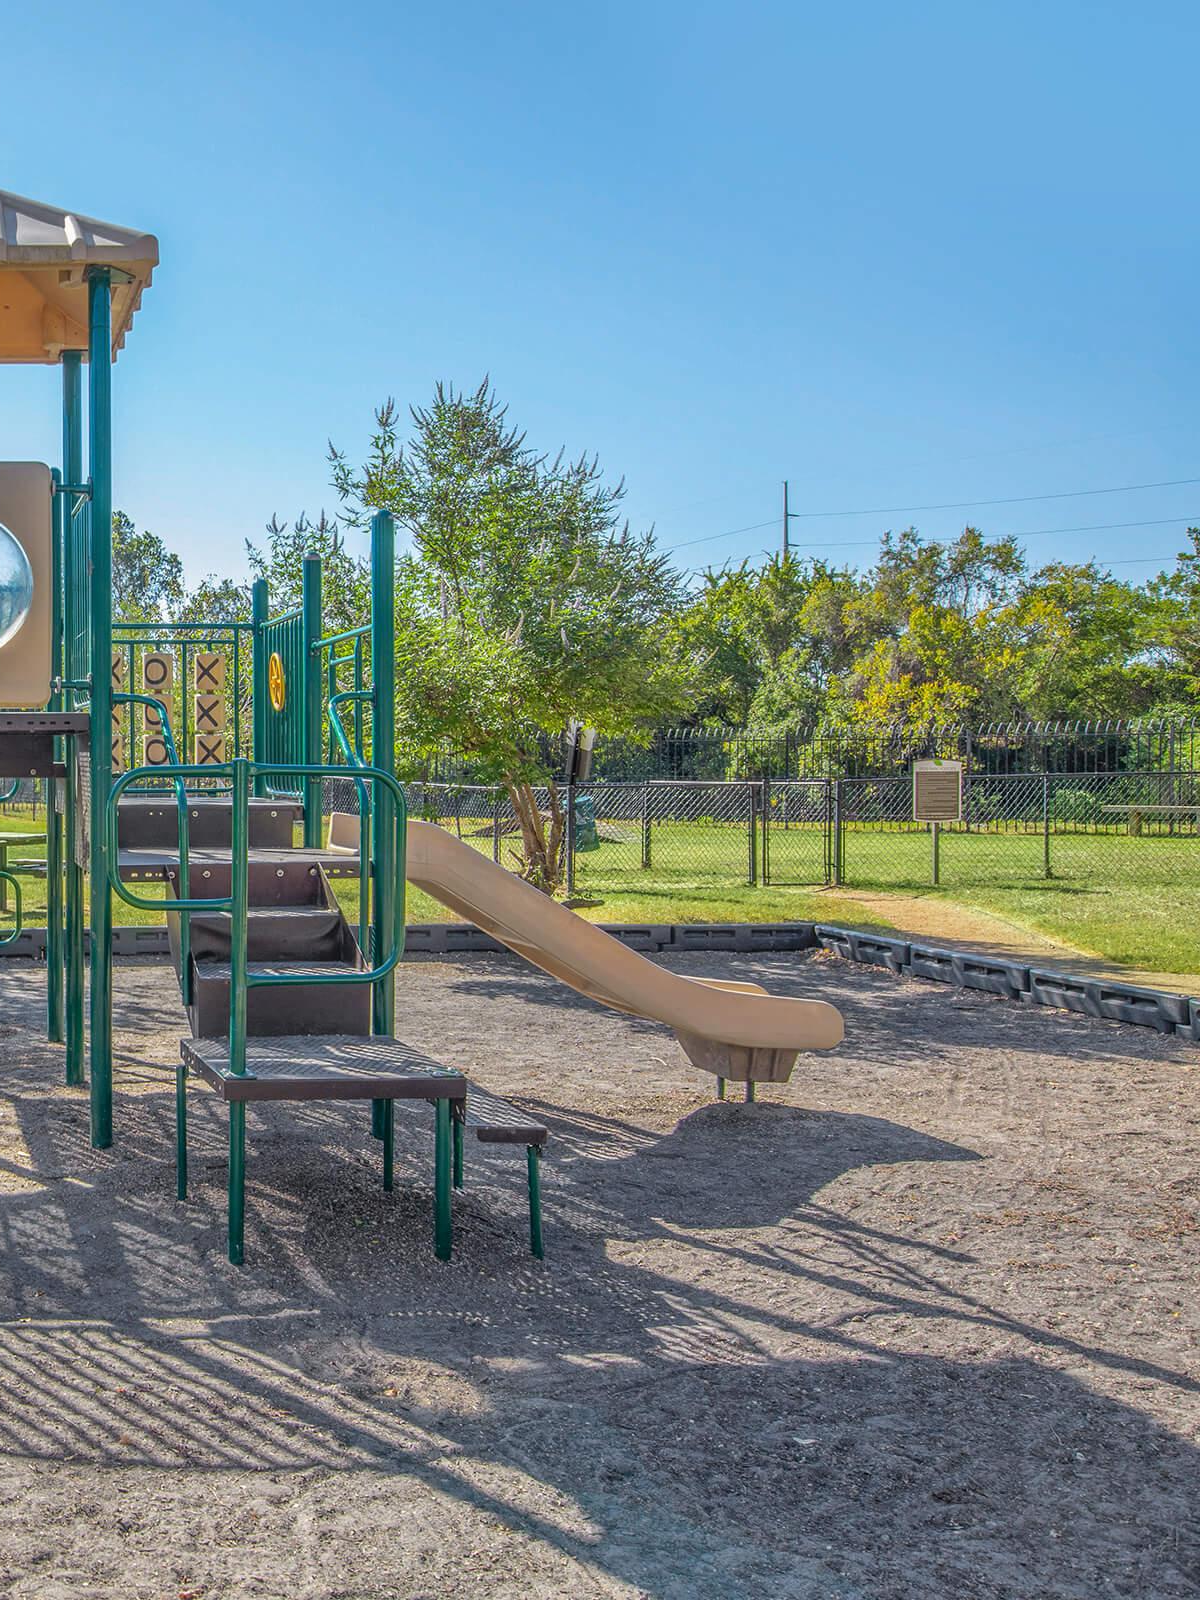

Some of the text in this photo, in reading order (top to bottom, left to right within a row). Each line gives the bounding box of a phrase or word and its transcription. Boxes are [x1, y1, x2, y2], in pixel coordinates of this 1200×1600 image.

[144, 658, 167, 685] O
[196, 658, 219, 685] X
[196, 700, 219, 727] X
[146, 739, 168, 765] O
[198, 739, 222, 764] X
